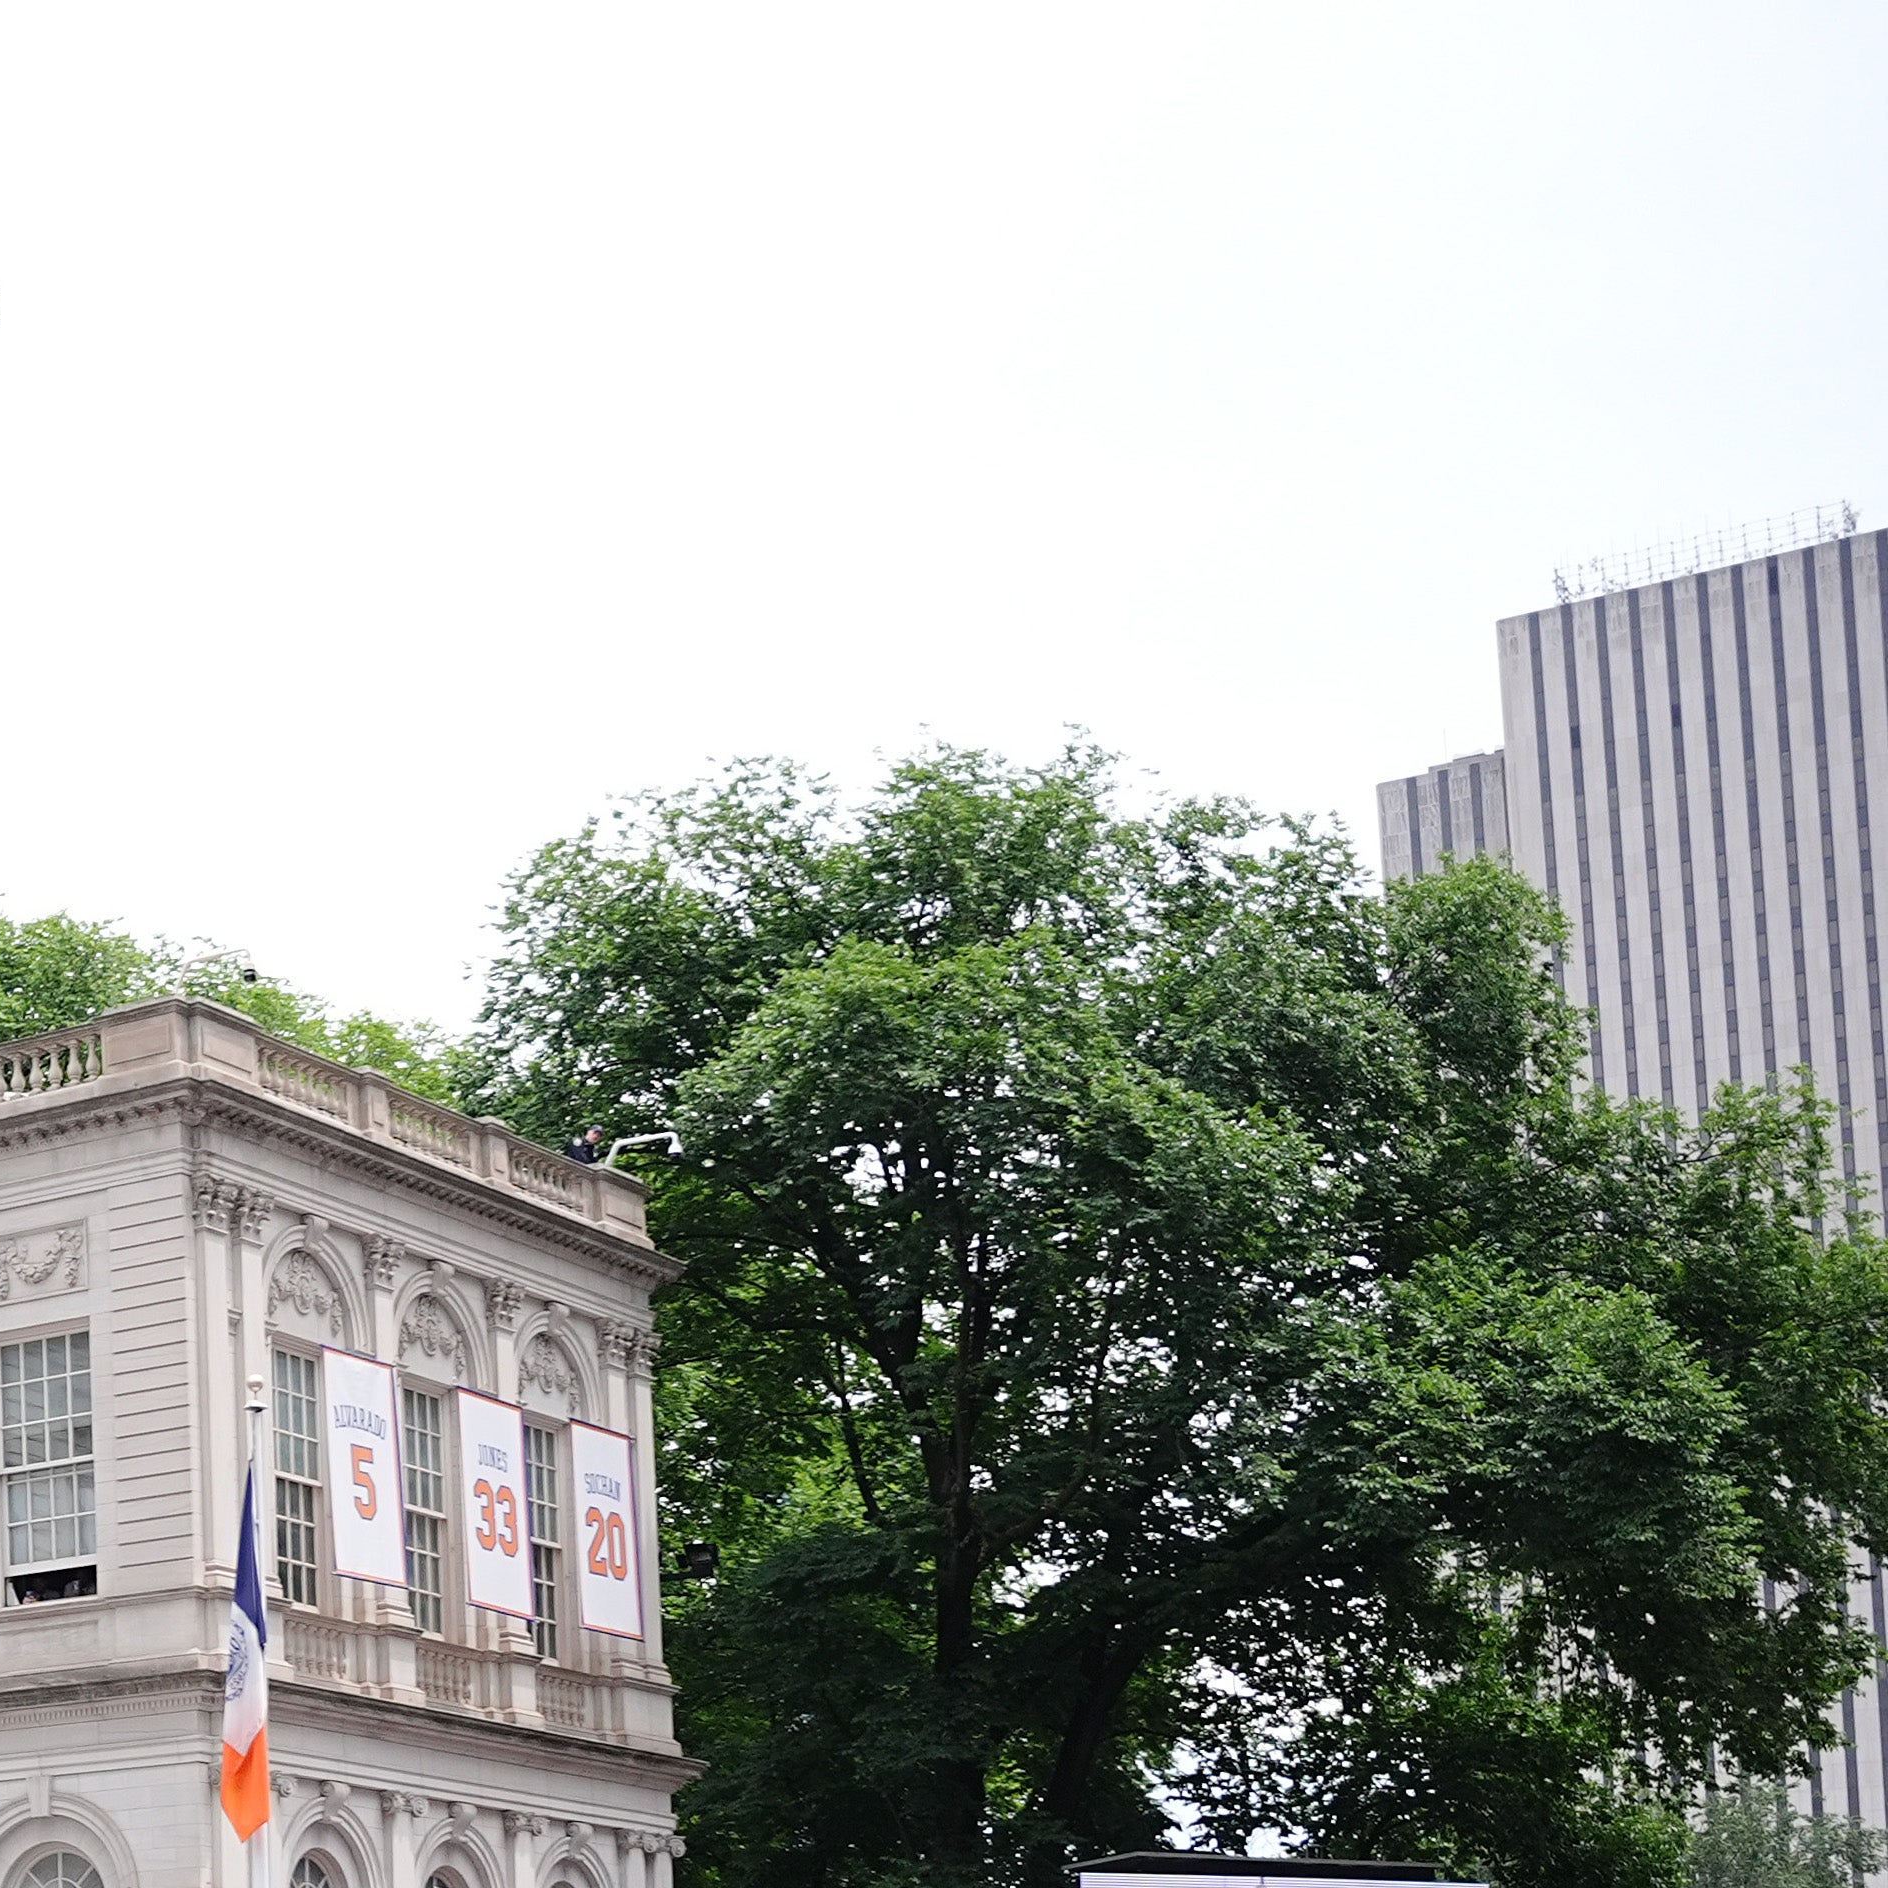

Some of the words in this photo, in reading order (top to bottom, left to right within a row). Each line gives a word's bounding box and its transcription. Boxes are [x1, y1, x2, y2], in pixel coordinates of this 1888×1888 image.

[333, 1405, 387, 1440] ALVARADO
[350, 1443, 377, 1520] 5
[478, 1444, 509, 1473] JONES
[584, 1472, 621, 1501] SOCHAN
[474, 1478, 518, 1557] 33
[585, 1506, 628, 1581] 20
